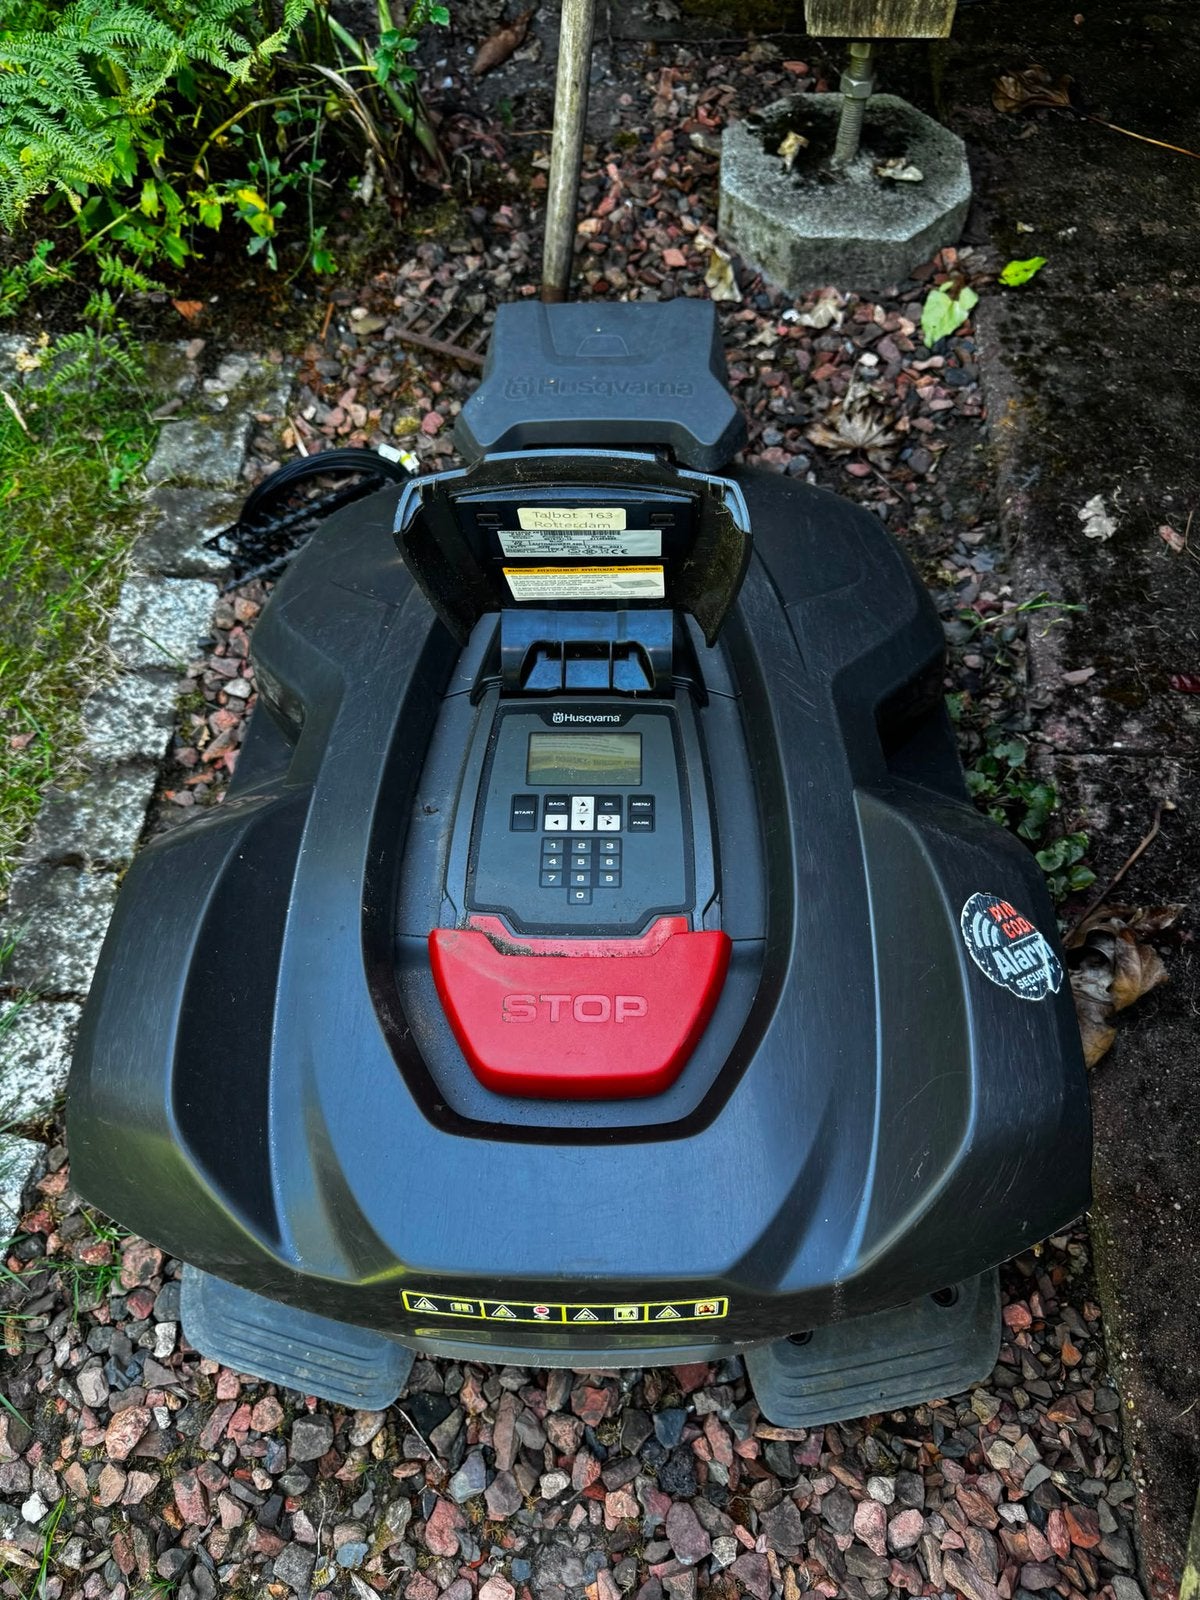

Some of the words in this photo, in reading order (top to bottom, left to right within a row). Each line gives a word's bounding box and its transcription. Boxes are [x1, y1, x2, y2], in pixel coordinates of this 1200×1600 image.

[537, 378, 694, 398] Husqvarna
[532, 511, 577, 520] Talbot
[589, 511, 614, 520] 163
[534, 521, 611, 529] Rotterdam
[564, 713, 622, 724] Husqvarna
[988, 901, 1018, 922] PIN
[1015, 963, 1056, 989] SECURY
[502, 994, 649, 1024] STOP
